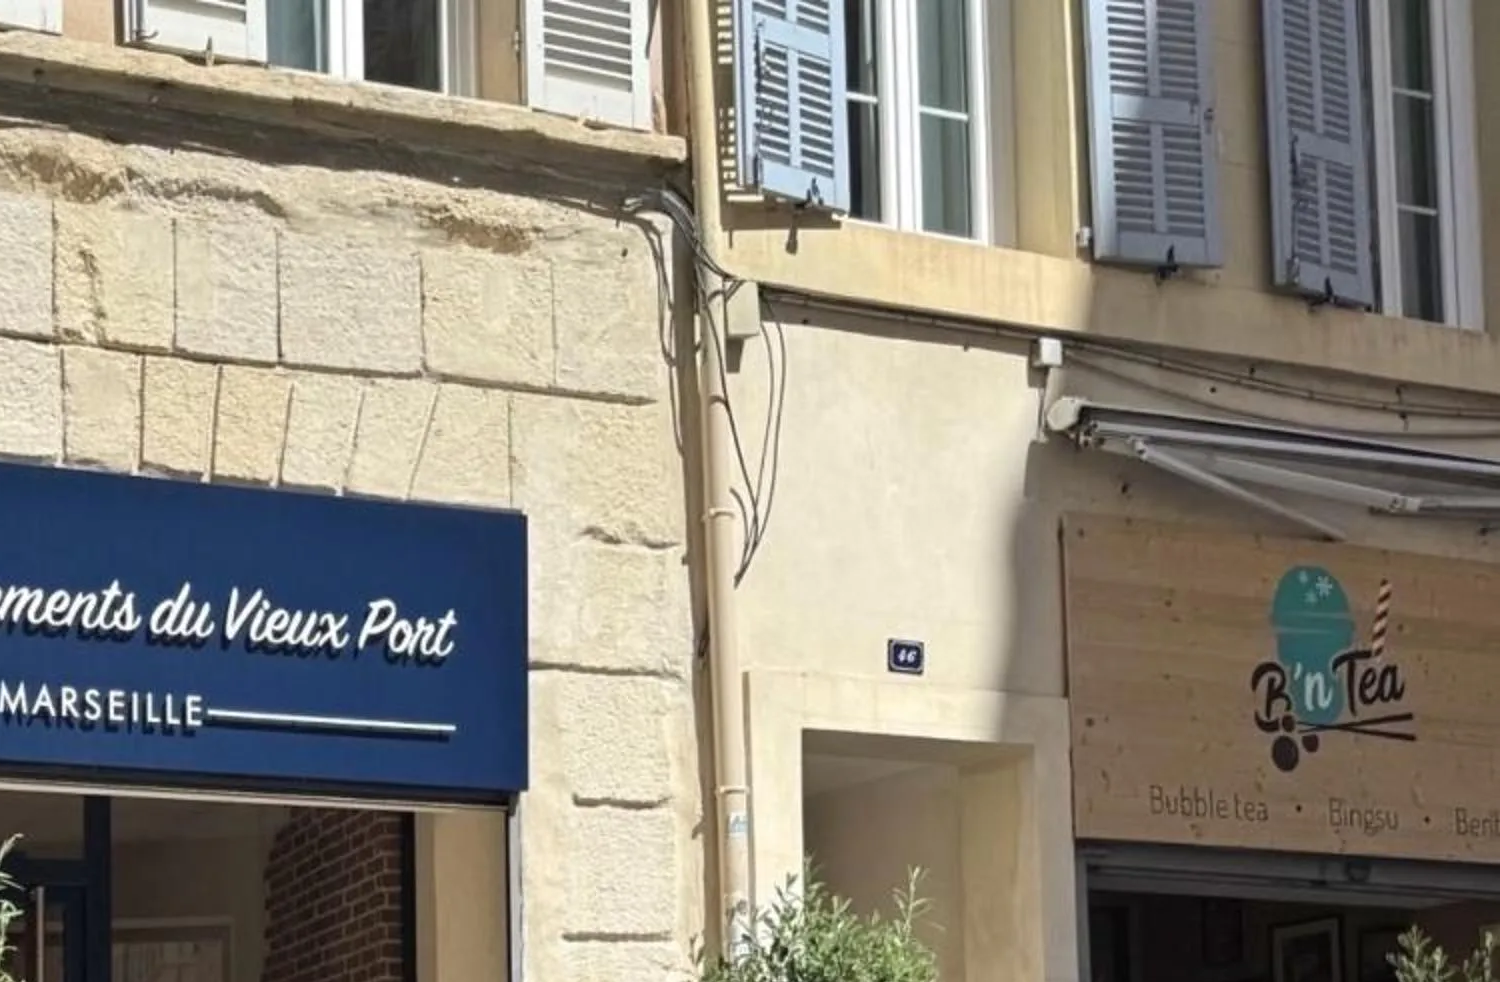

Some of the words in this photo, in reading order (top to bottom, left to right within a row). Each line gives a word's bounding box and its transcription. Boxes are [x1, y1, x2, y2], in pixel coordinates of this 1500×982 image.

[150, 580, 215, 638] du
[224, 586, 350, 648] Vieux
[357, 598, 458, 657] Port
[897, 648, 918, 663] 46
[1332, 648, 1406, 717] Tea
[1149, 783, 1229, 819] Bubble
[1233, 792, 1269, 822] tea
[1328, 796, 1399, 837] Bingsu
